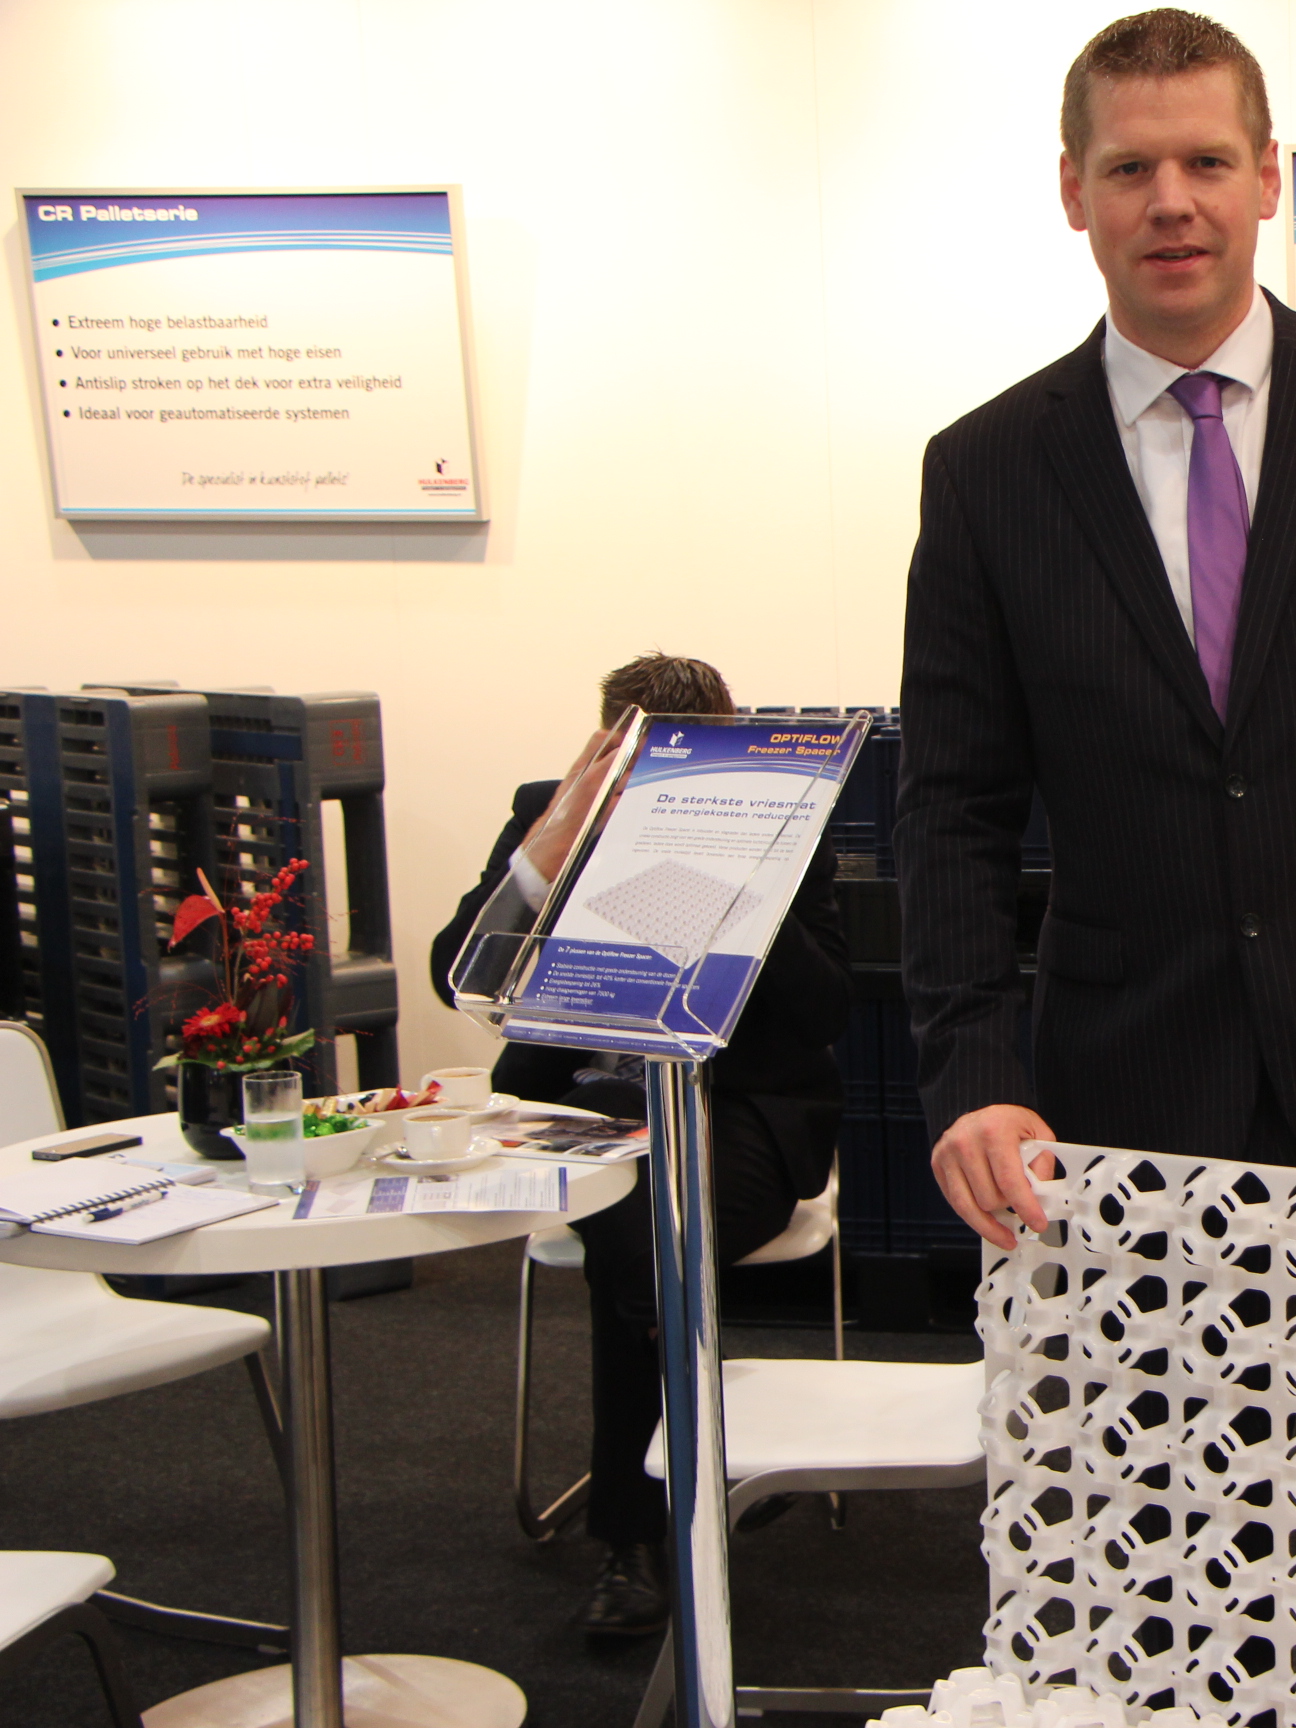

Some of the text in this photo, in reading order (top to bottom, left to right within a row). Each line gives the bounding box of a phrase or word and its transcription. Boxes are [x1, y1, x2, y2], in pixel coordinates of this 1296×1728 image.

[38, 204, 199, 222] CR Palletserie
[68, 315, 268, 332] Extreem hoge belastbaarheid
[71, 345, 342, 362] Voor universeel gebruik met hoge eisen
[75, 375, 402, 392] Antislip stroken op het dek voor extra veiligheid
[78, 406, 350, 423] Ideaal voor geautomatiseerde systemen
[770, 733, 841, 745] OPTIFLOW
[747, 745, 841, 756] Freezer Spacer
[657, 793, 817, 810] De sterkste vriesmat
[651, 807, 811, 821] die energiekosten reduceert
